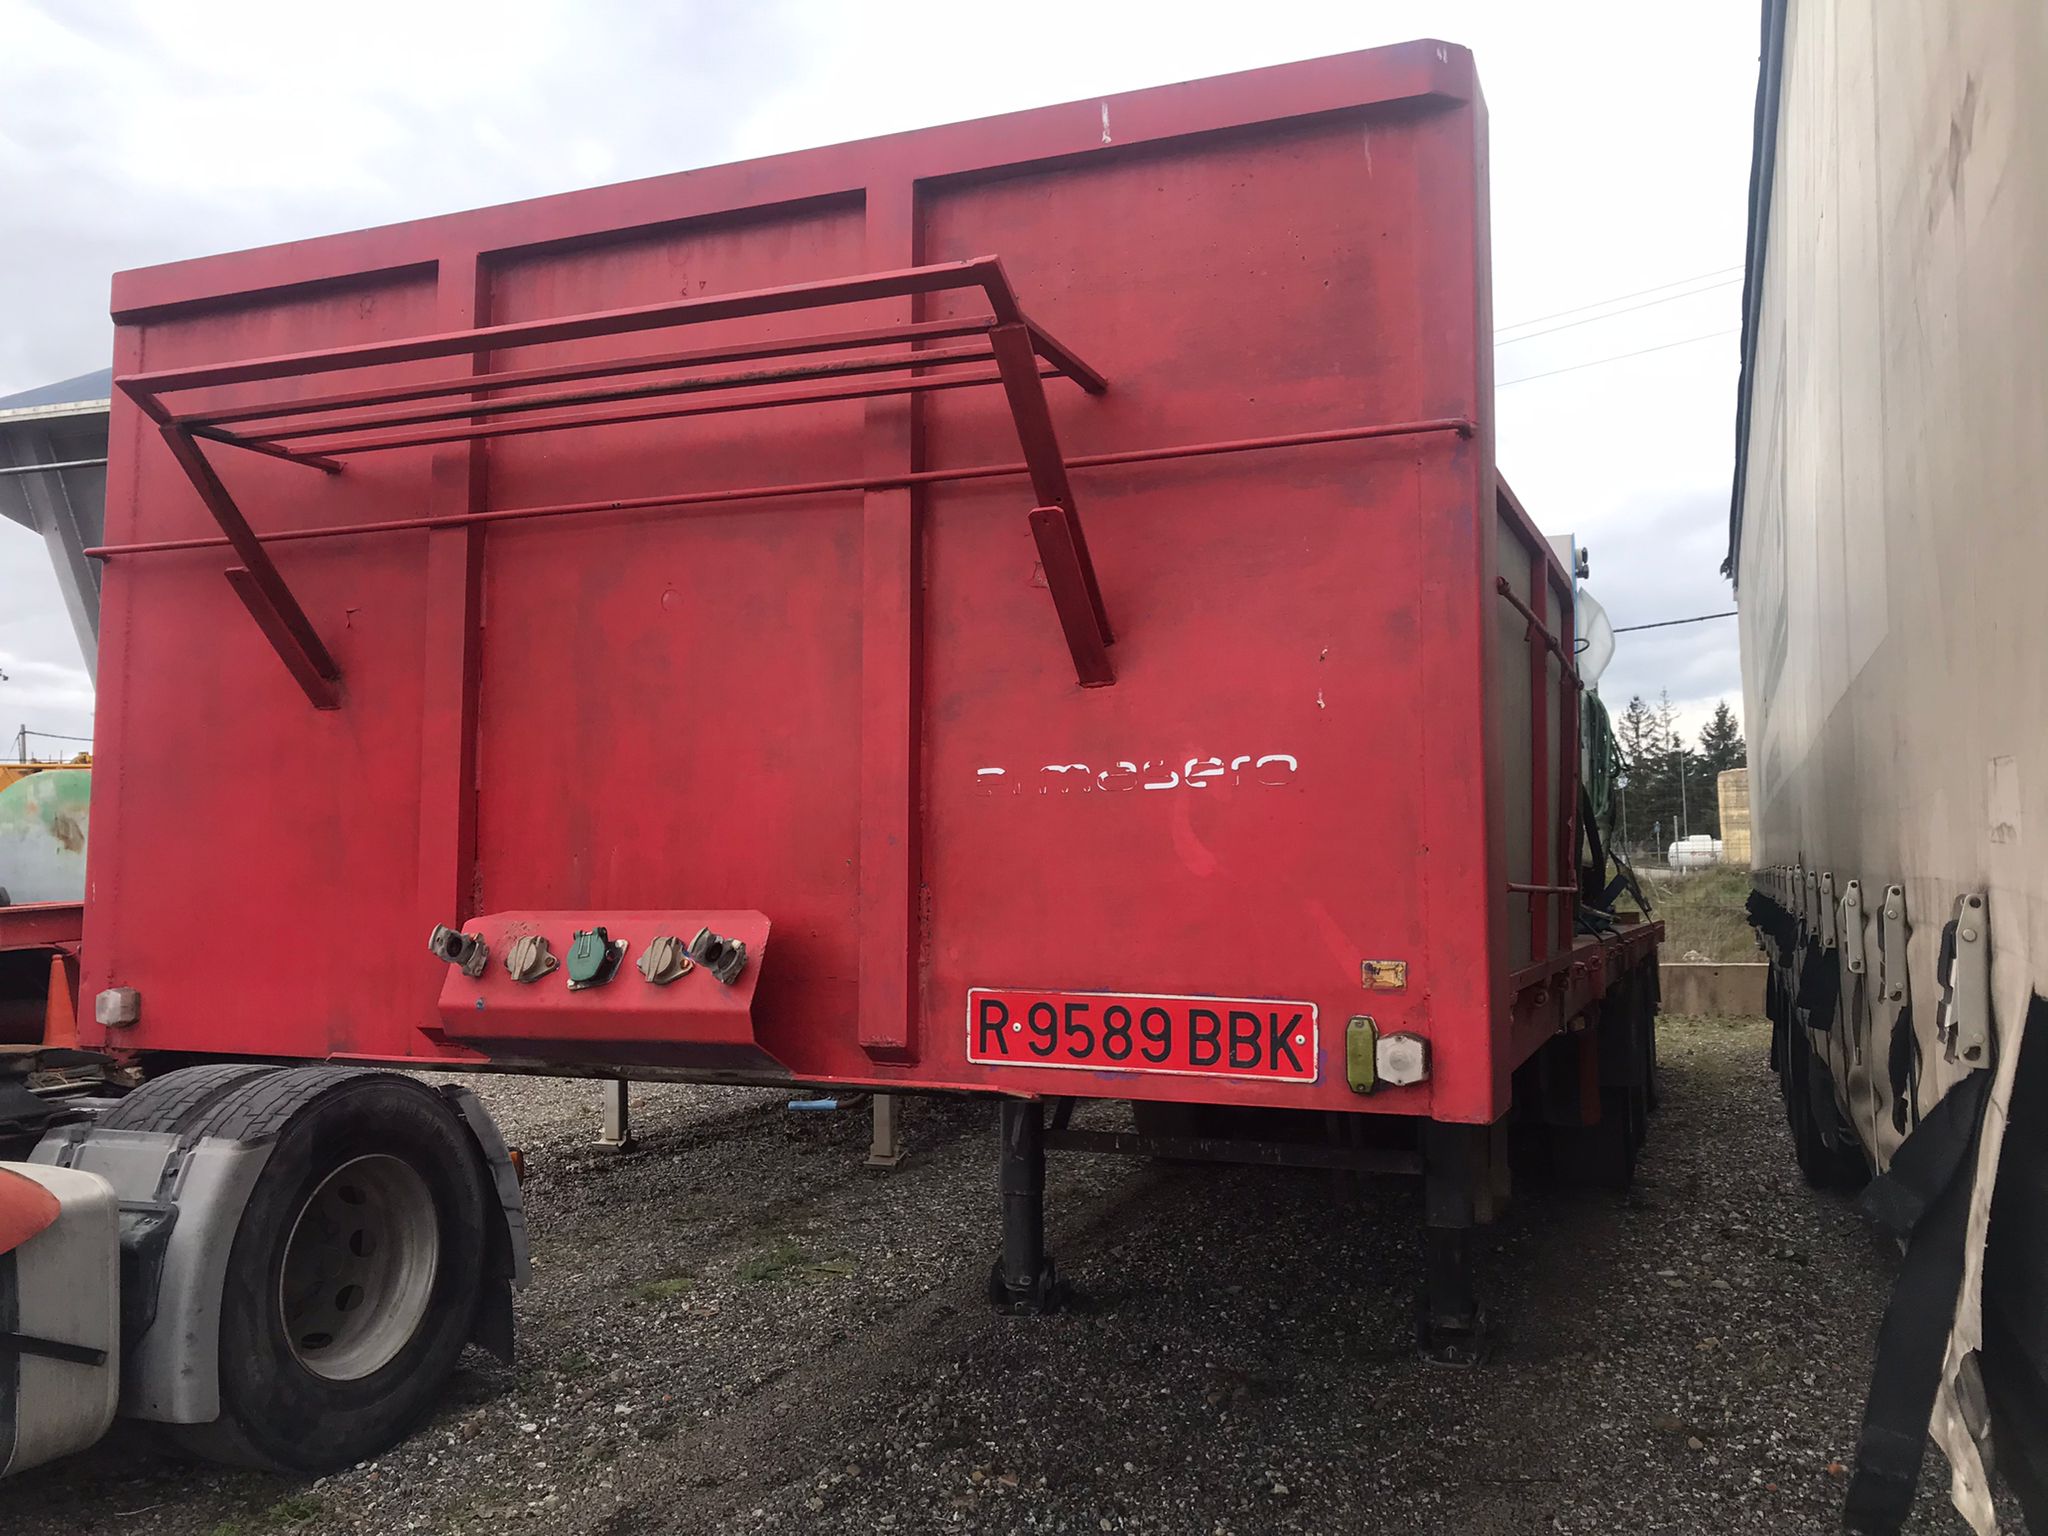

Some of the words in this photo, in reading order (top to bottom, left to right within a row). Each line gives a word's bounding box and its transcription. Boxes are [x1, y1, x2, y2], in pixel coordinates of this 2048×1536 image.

[979, 999, 1009, 1055] R
[1027, 1002, 1172, 1063] 9589
[1188, 1008, 1304, 1072] BBK
